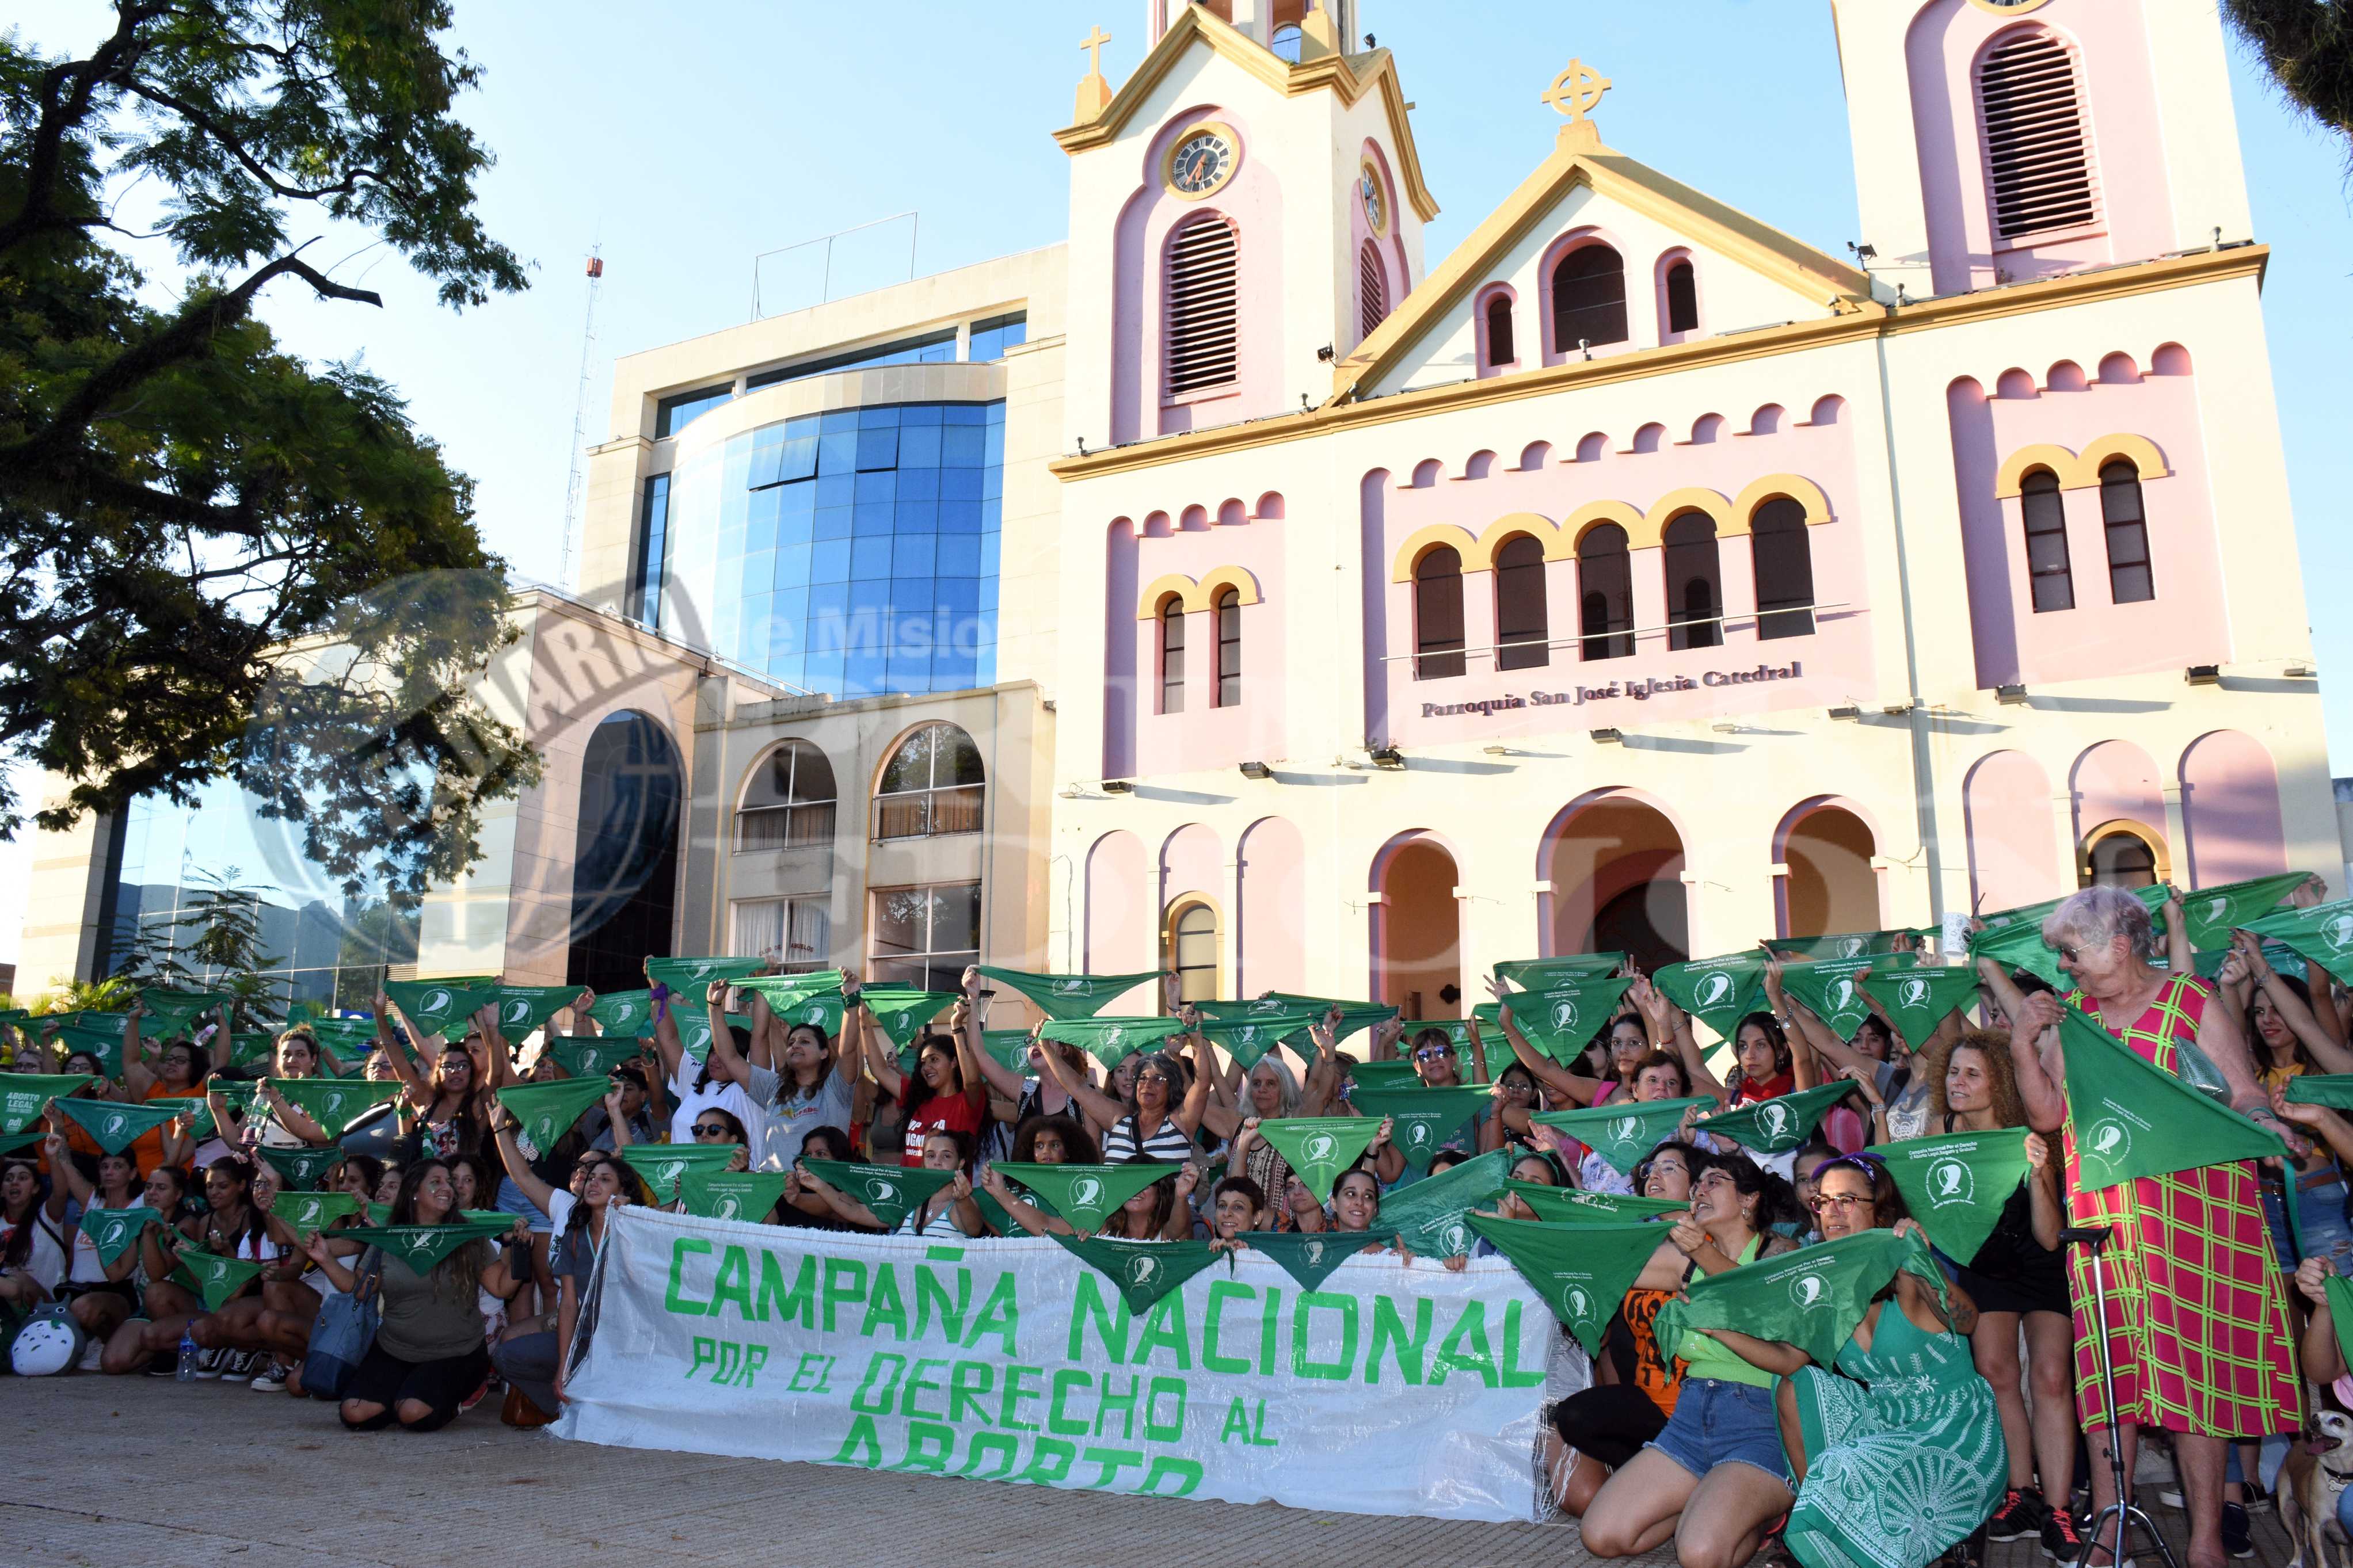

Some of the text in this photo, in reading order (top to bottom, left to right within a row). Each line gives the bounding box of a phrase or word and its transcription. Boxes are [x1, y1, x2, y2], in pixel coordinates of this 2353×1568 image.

[1421, 662, 1804, 718] Parroquia San José Iglesia Catedral
[791, 943, 813, 952] ABUELOS
[6, 1092, 40, 1101] ABORTO
[8, 1100, 33, 1109] LEGAL
[1765, 1271, 1784, 1280] Campaña
[1784, 1264, 1803, 1272] Nacional
[665, 1237, 1547, 1388] CAMPAÑA NACIONAL
[684, 1336, 1278, 1447] POR EL DERECHO AL
[816, 1413, 1204, 1497] ABORTO
